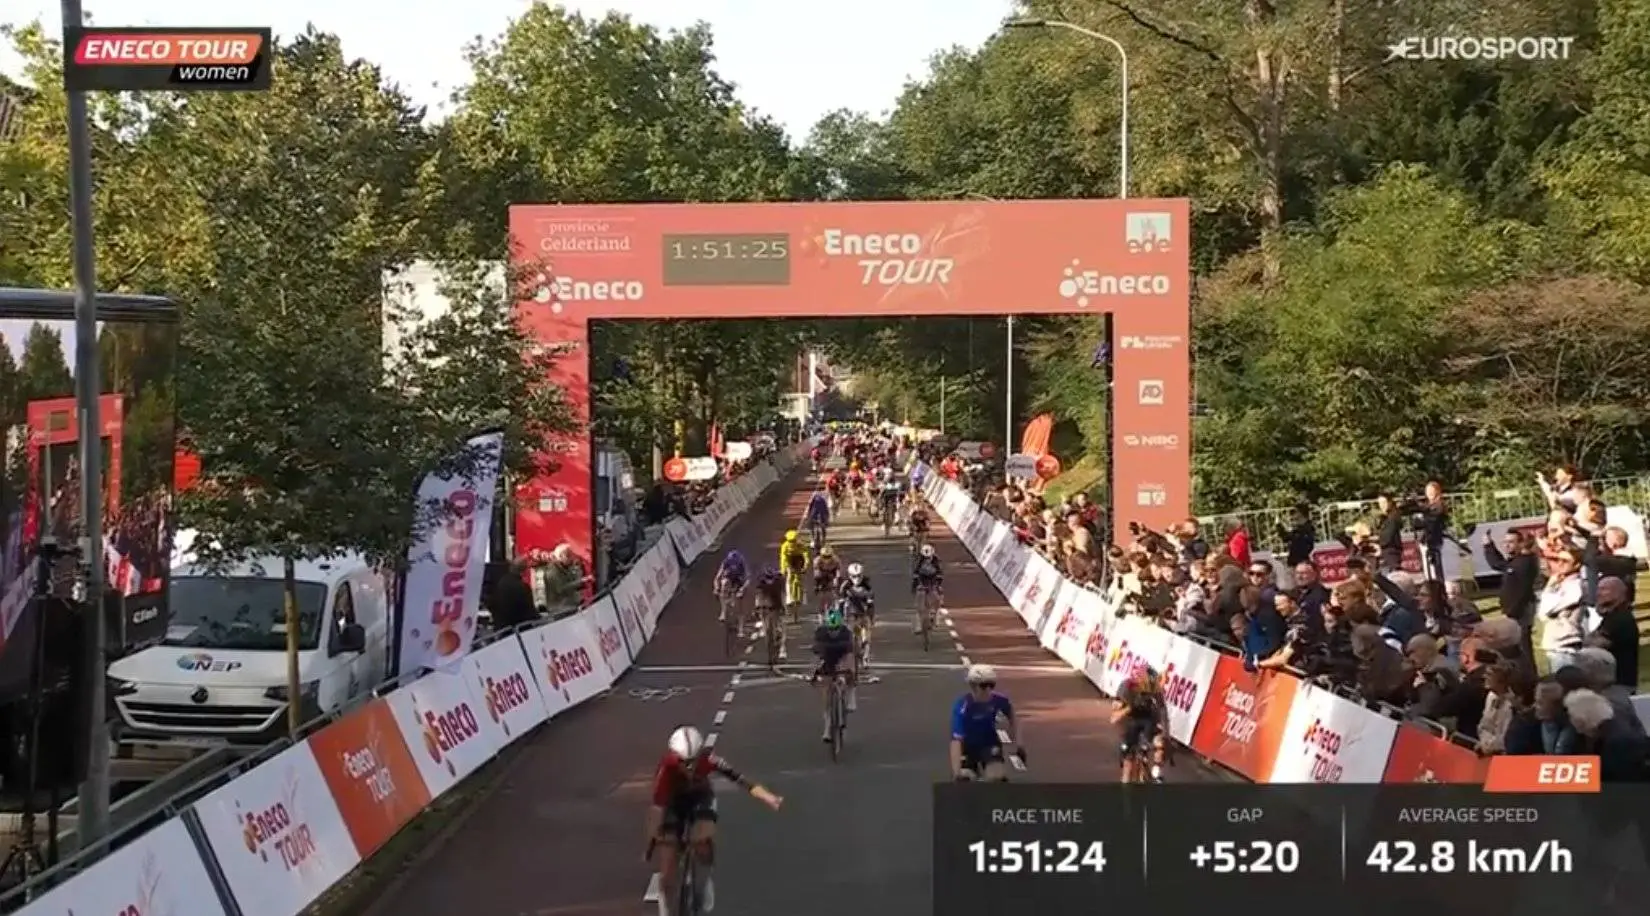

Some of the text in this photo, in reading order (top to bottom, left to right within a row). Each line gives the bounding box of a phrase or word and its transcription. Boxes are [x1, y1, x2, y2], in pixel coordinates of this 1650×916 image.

[549, 219, 609, 235] provincie
[823, 228, 921, 255] Eneco
[540, 236, 631, 251] Gelderland
[671, 240, 787, 260] 1:51:25
[858, 259, 954, 284] TOUR
[1083, 270, 1170, 295] Eneco
[556, 276, 644, 301] Eneco
[1141, 385, 1162, 399] AD
[431, 489, 477, 625] Eneco
[194, 660, 243, 672] NEP
[551, 646, 593, 685] Eneco
[486, 672, 530, 715] Eneco
[1163, 663, 1198, 713] Eneco
[1224, 682, 1255, 714] Eneco
[425, 702, 480, 752] Eneco
[1221, 711, 1257, 743] TOUR
[343, 748, 376, 779] Eneco
[366, 767, 396, 803] TOUR
[246, 802, 290, 844] Eneco
[274, 823, 317, 871] TOUR
